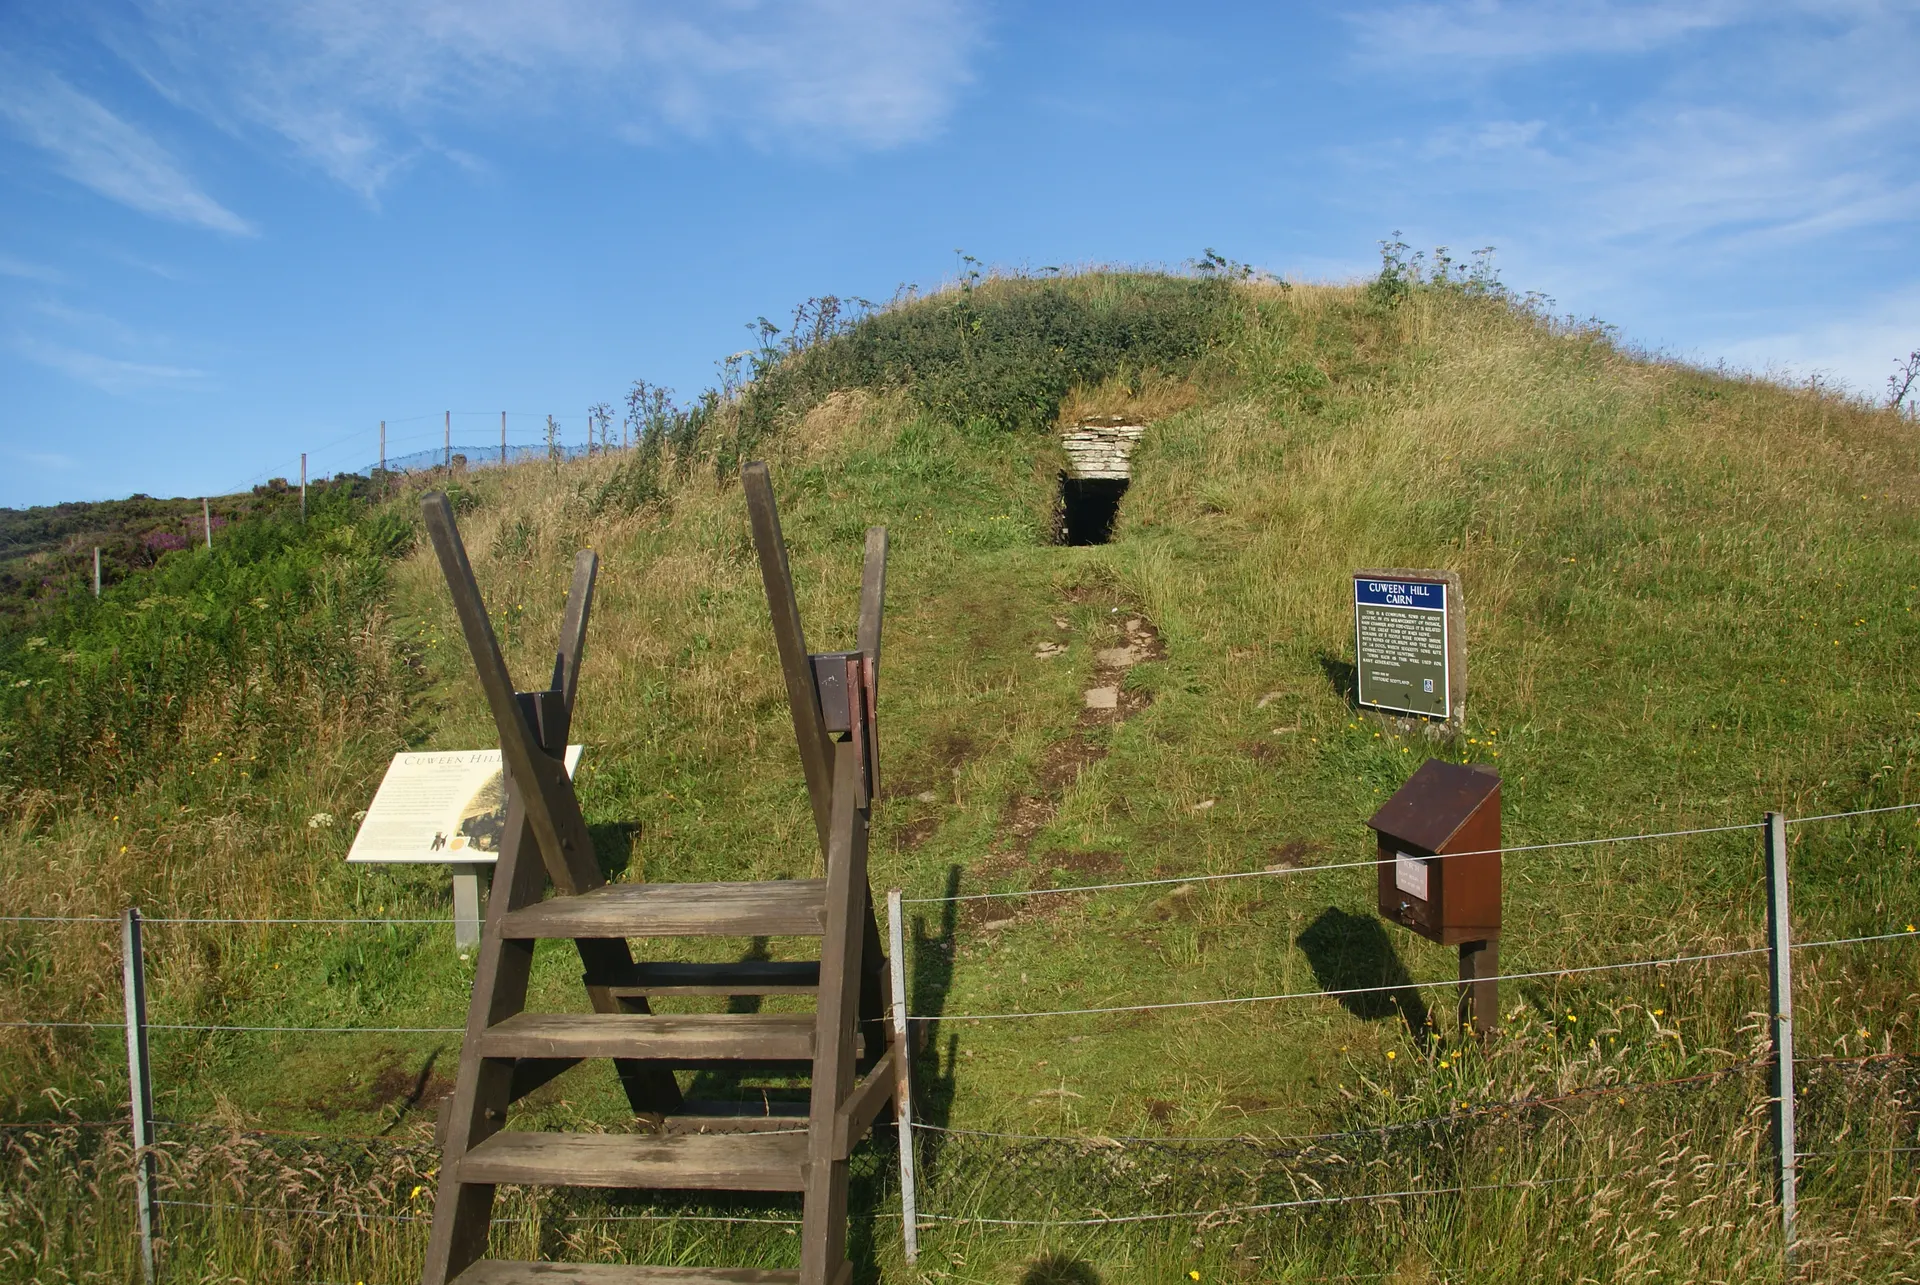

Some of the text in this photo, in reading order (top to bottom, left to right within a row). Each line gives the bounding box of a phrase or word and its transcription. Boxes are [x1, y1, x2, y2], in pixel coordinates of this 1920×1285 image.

[1369, 583, 1429, 596] CUWEEN HILL
[1386, 594, 1413, 605] CAIRN
[404, 756, 464, 766] CUWEEN
